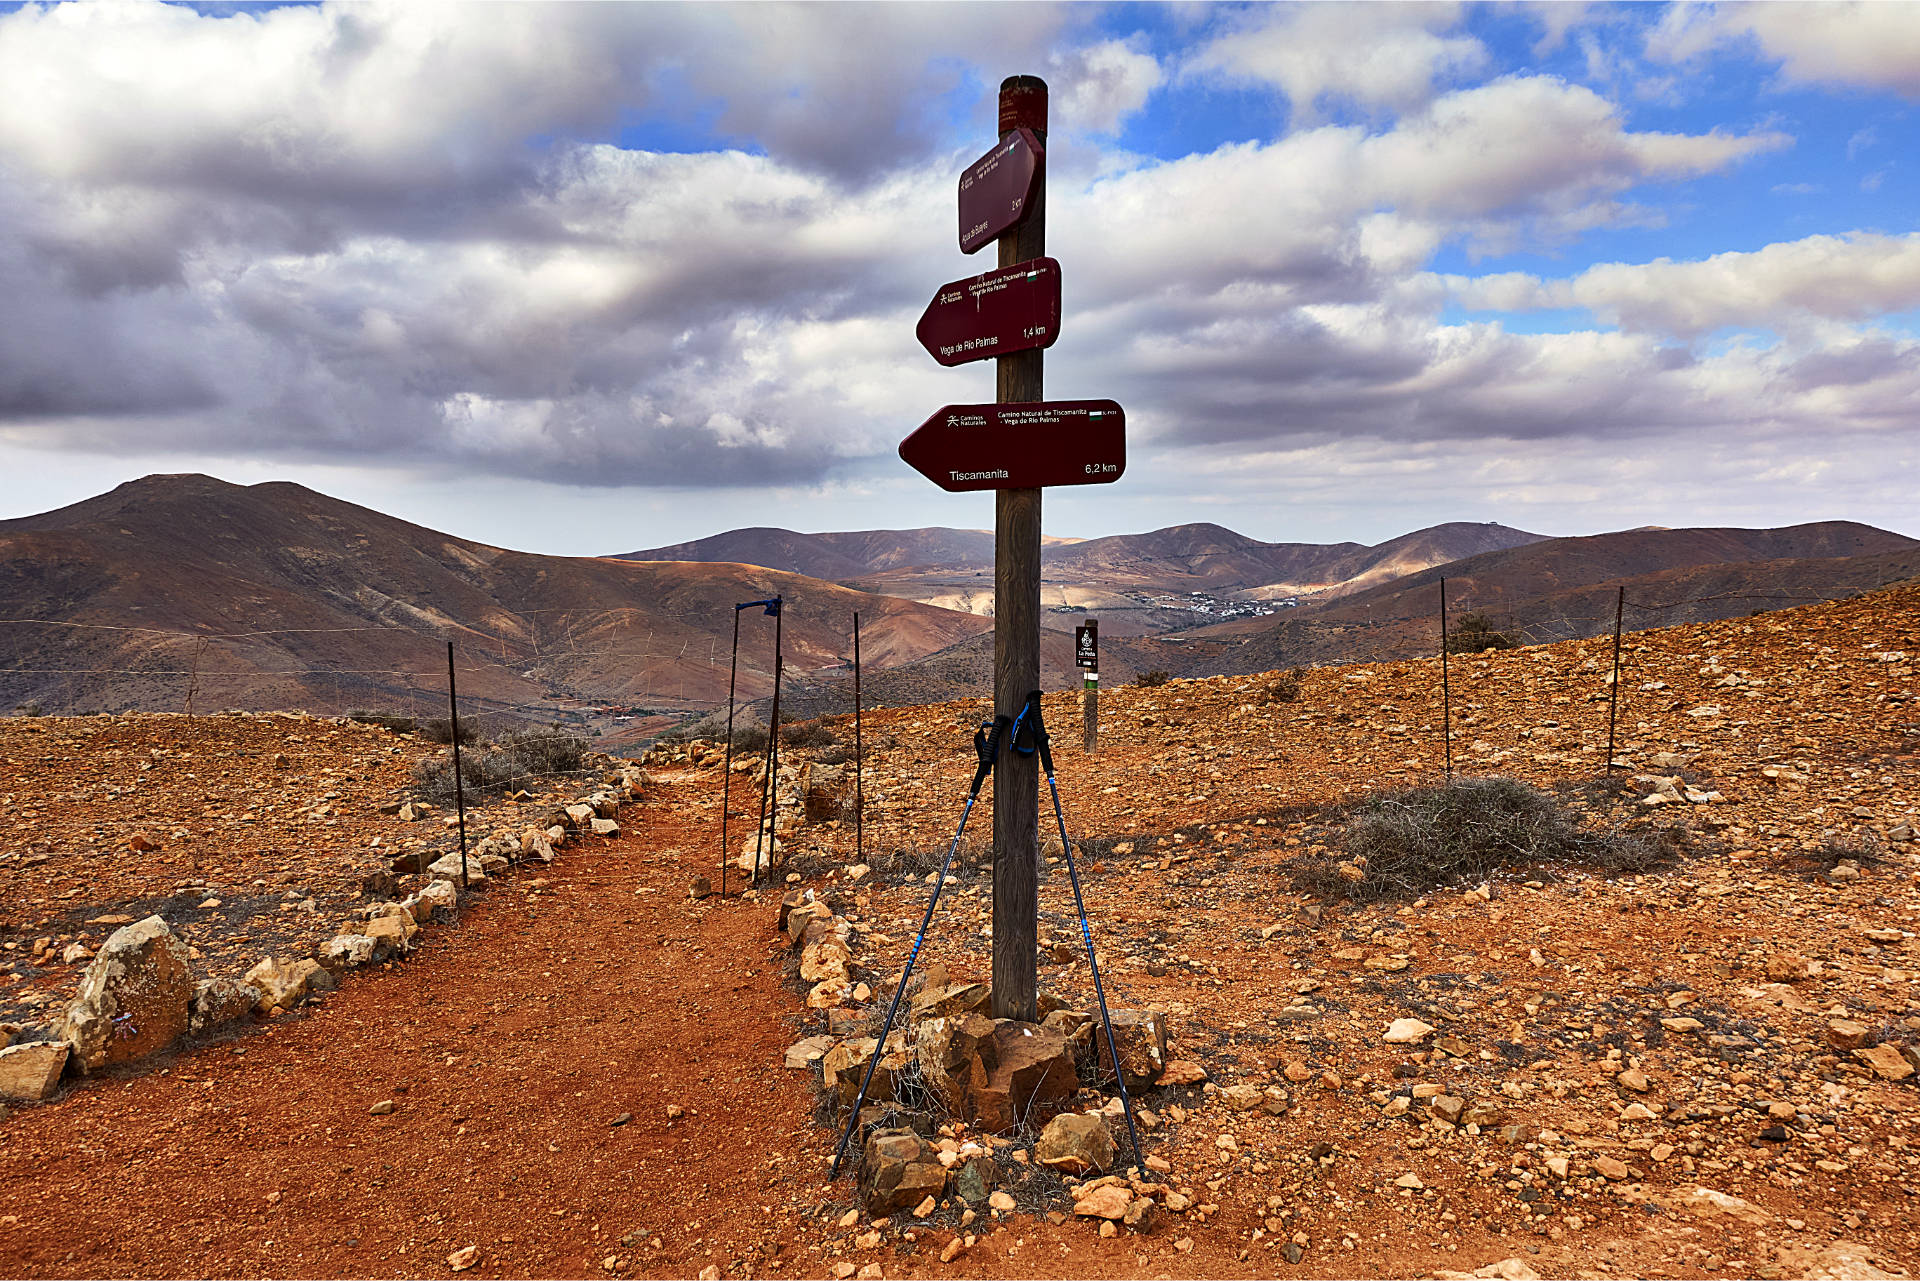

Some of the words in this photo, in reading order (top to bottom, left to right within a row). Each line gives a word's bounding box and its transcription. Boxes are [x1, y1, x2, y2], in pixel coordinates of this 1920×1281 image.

[1023, 327, 1034, 339] 1,4
[1035, 325, 1046, 336] km
[940, 345, 955, 357] Vega
[955, 343, 963, 353] de
[975, 336, 998, 348] Palmas
[1053, 408, 1087, 416] Tiscamanita
[1004, 418, 1018, 426] Vega
[1085, 464, 1100, 474] 6,2
[1102, 463, 1117, 473] km
[949, 469, 1008, 481] Tiscamanita
